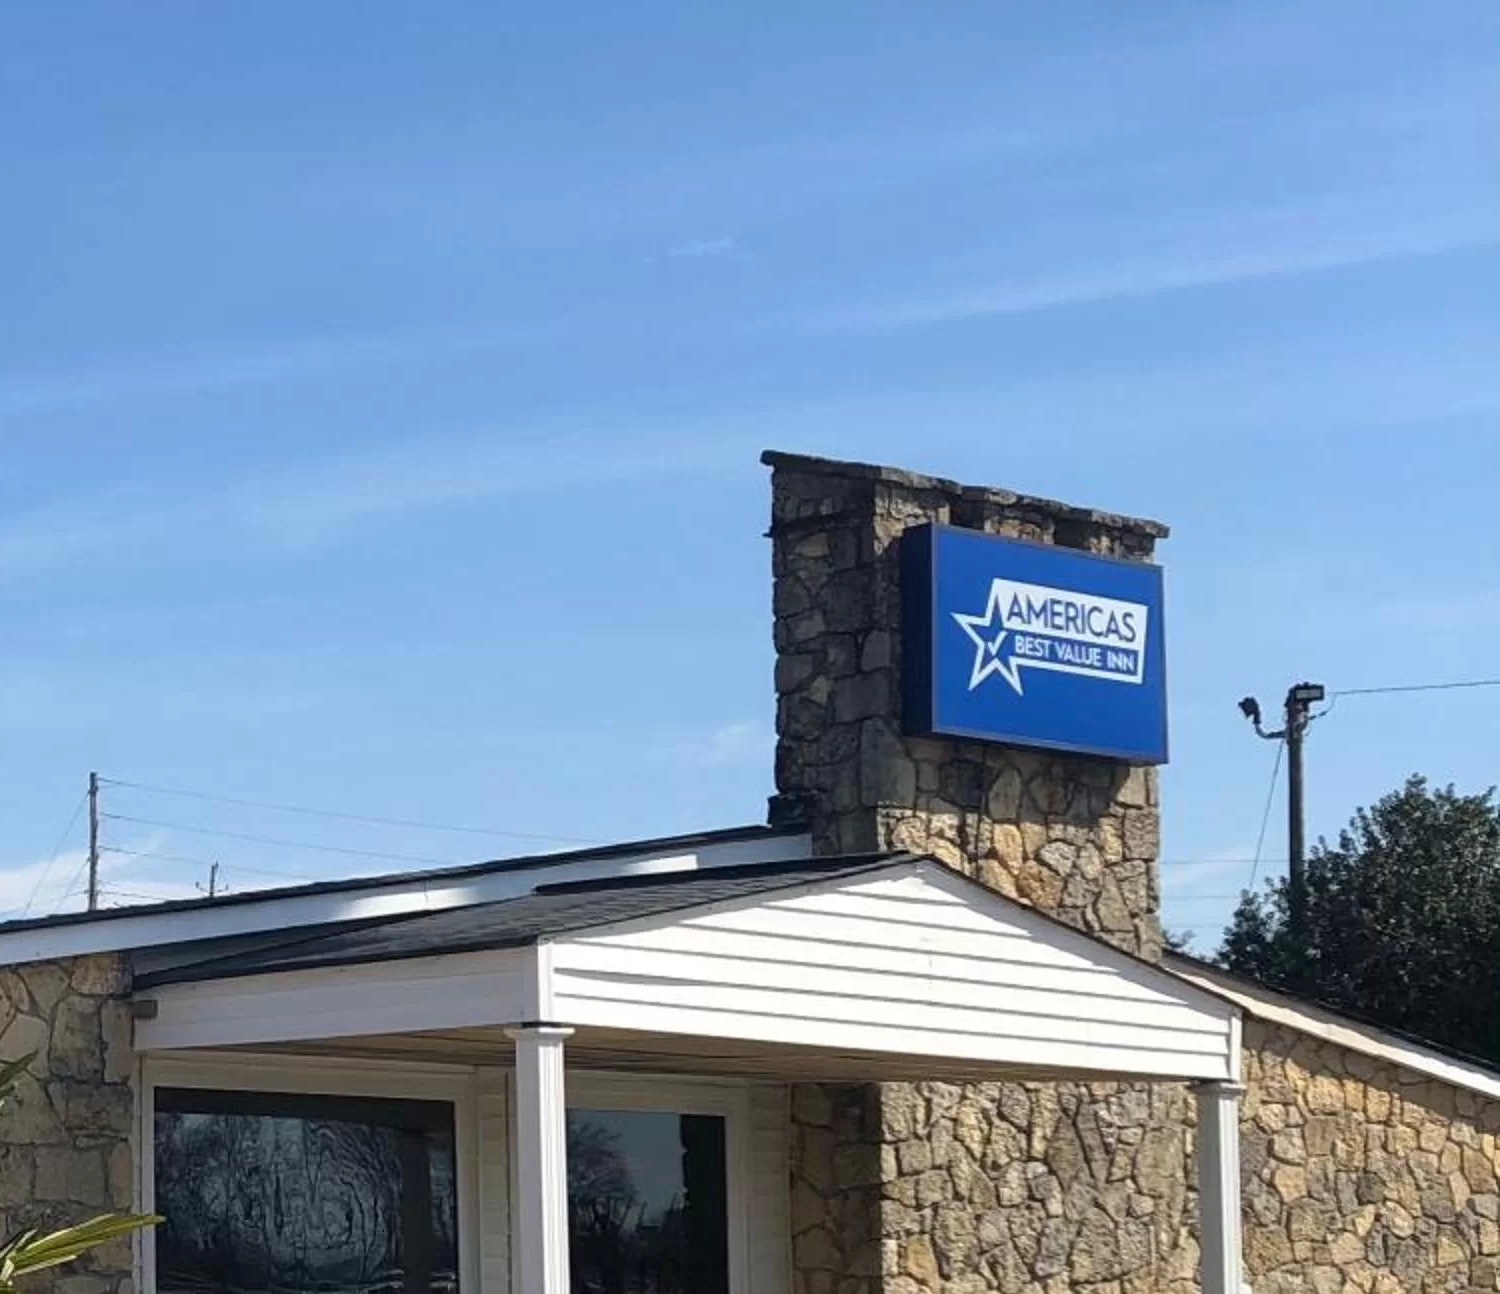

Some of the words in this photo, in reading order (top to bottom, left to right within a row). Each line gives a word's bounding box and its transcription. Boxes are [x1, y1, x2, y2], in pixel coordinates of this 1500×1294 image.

[1006, 591, 1137, 643] AMERICAS
[1014, 634, 1050, 659] BEST
[1053, 641, 1103, 668] VALUE
[1107, 649, 1136, 673] INN
